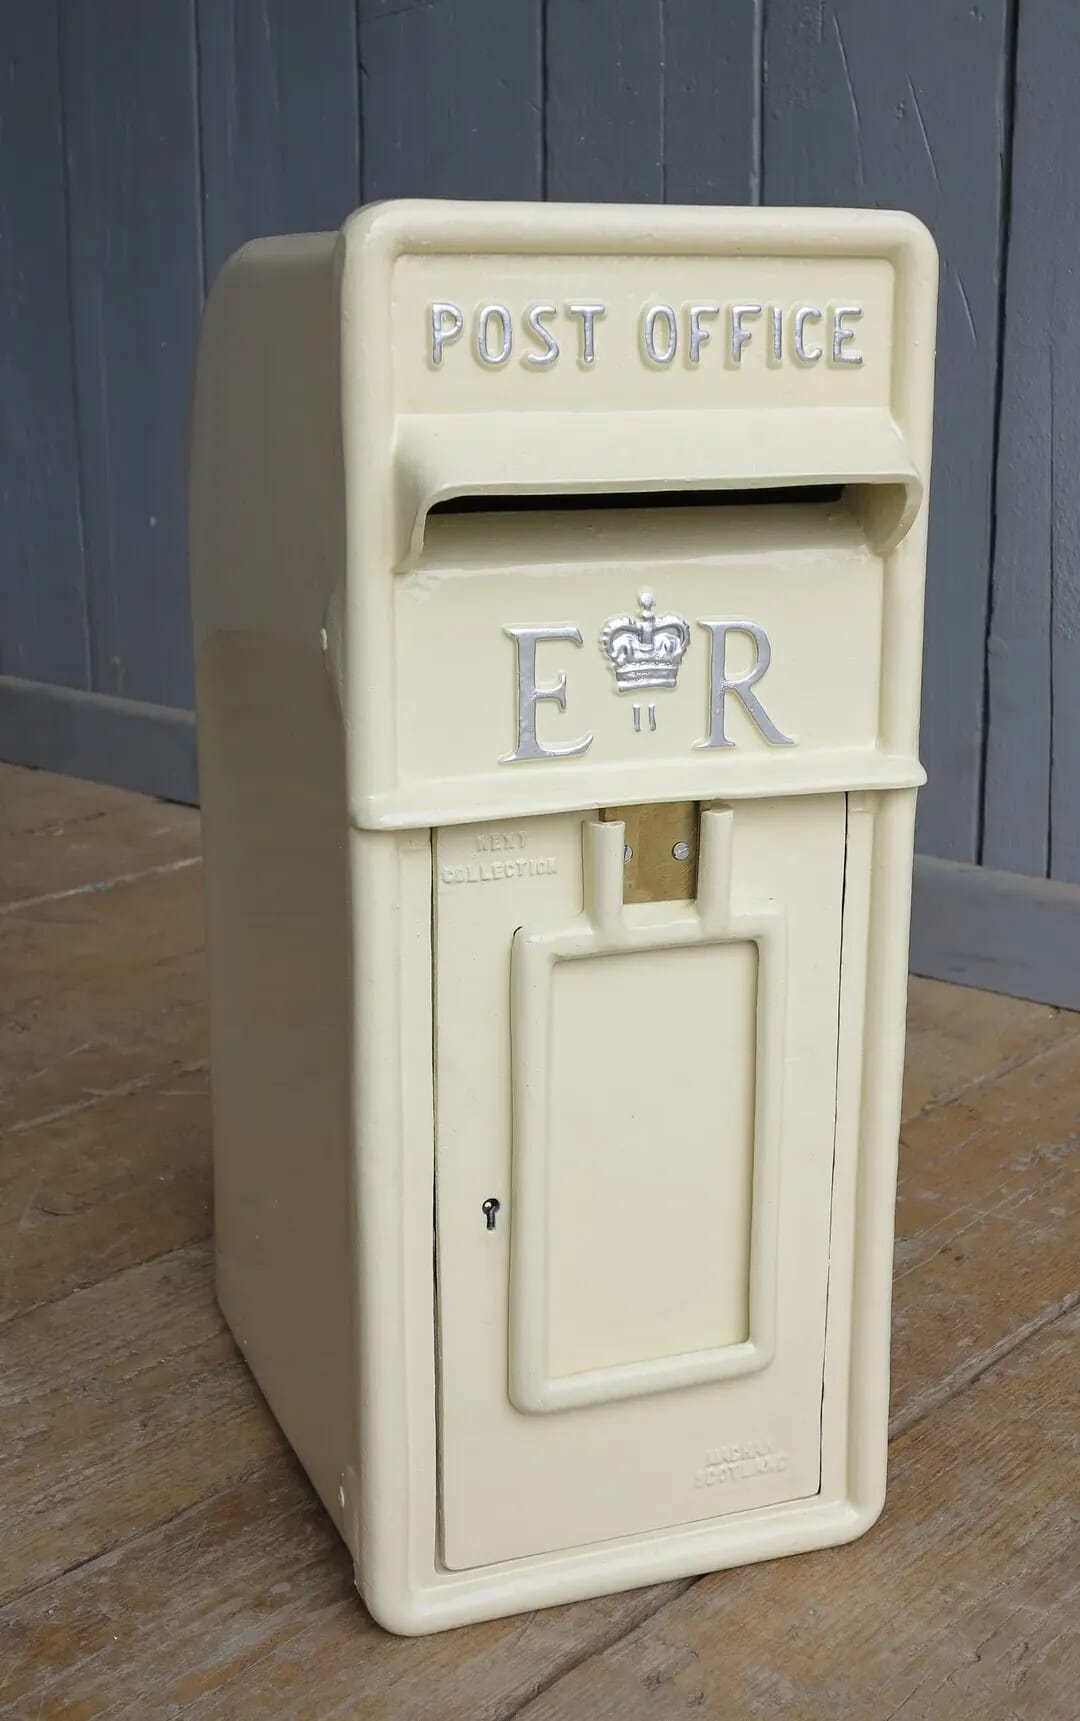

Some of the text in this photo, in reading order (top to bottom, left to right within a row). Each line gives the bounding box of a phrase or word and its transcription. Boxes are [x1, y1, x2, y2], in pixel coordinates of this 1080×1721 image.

[430, 301, 864, 366] POST OFFICE
[500, 618, 797, 763] E R
[475, 831, 528, 853] NEXT
[440, 857, 558, 885] COLLECTION
